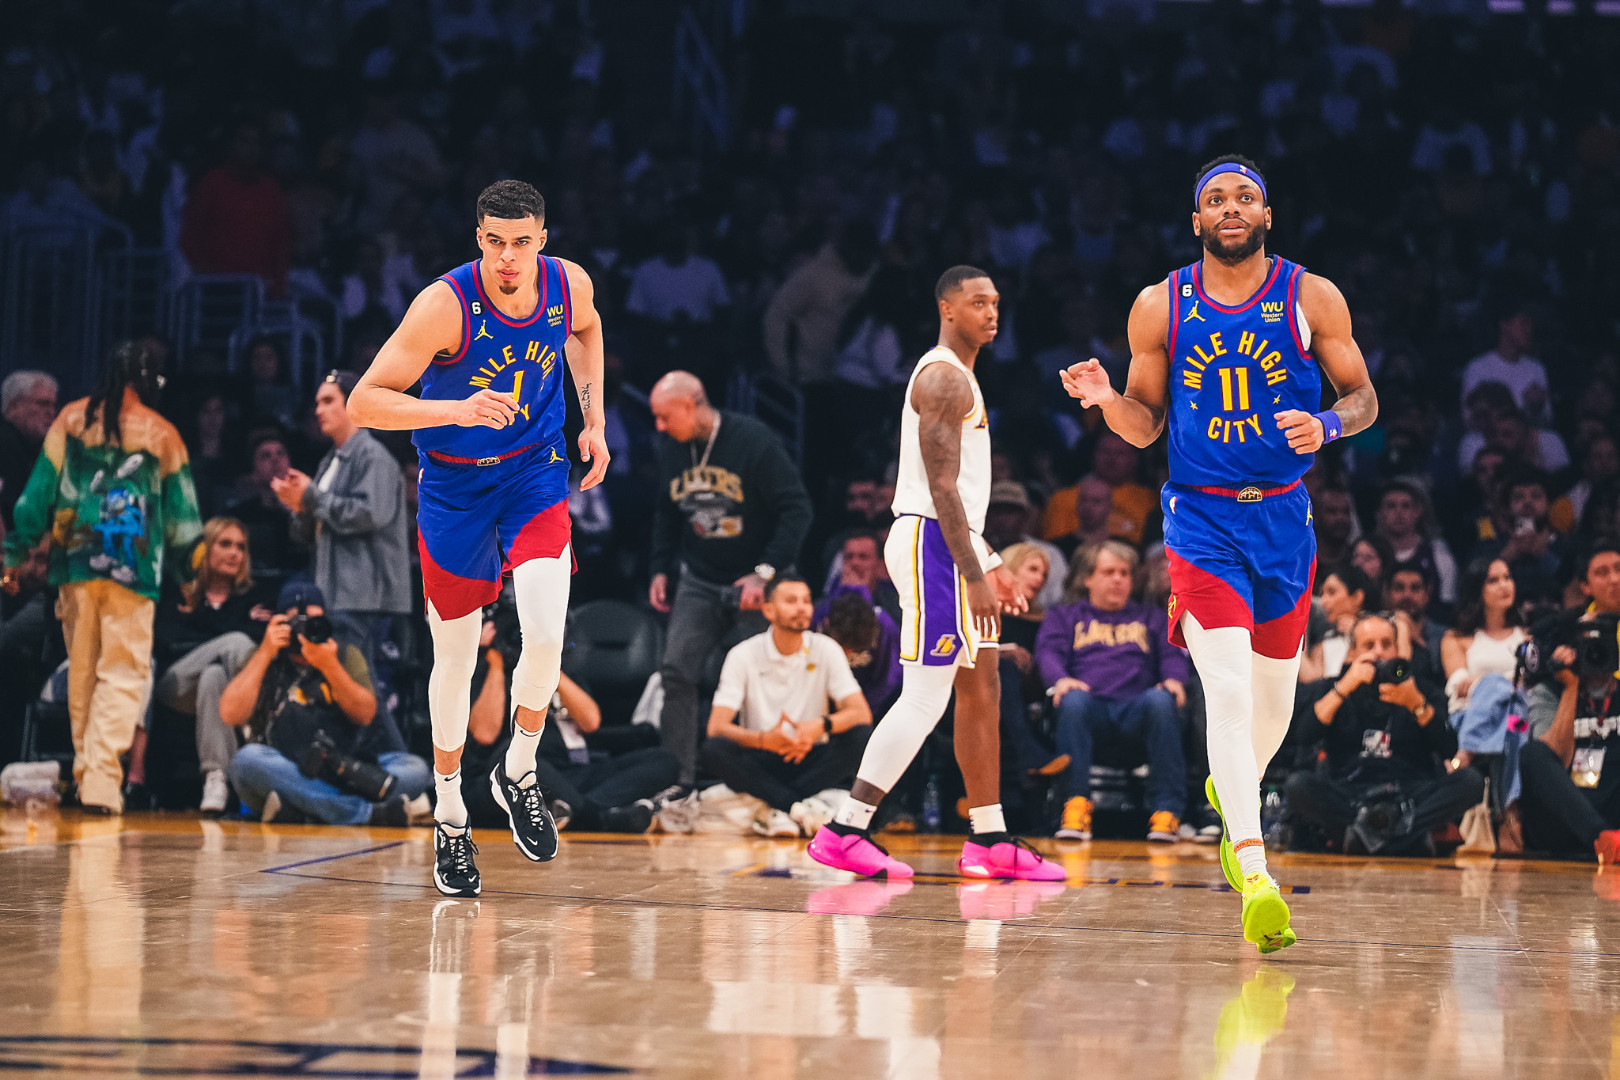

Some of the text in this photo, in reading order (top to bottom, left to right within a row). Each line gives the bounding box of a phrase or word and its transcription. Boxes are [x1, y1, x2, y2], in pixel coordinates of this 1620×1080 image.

[1182, 284, 1193, 297] 6
[471, 301, 482, 315] 6
[546, 304, 564, 318] WU
[1260, 301, 1284, 313] WU
[468, 344, 517, 389] MILE
[1183, 330, 1287, 390] MILE HIGH
[513, 370, 525, 403] 1
[1218, 366, 1250, 412] 11
[1207, 413, 1263, 443] CITY
